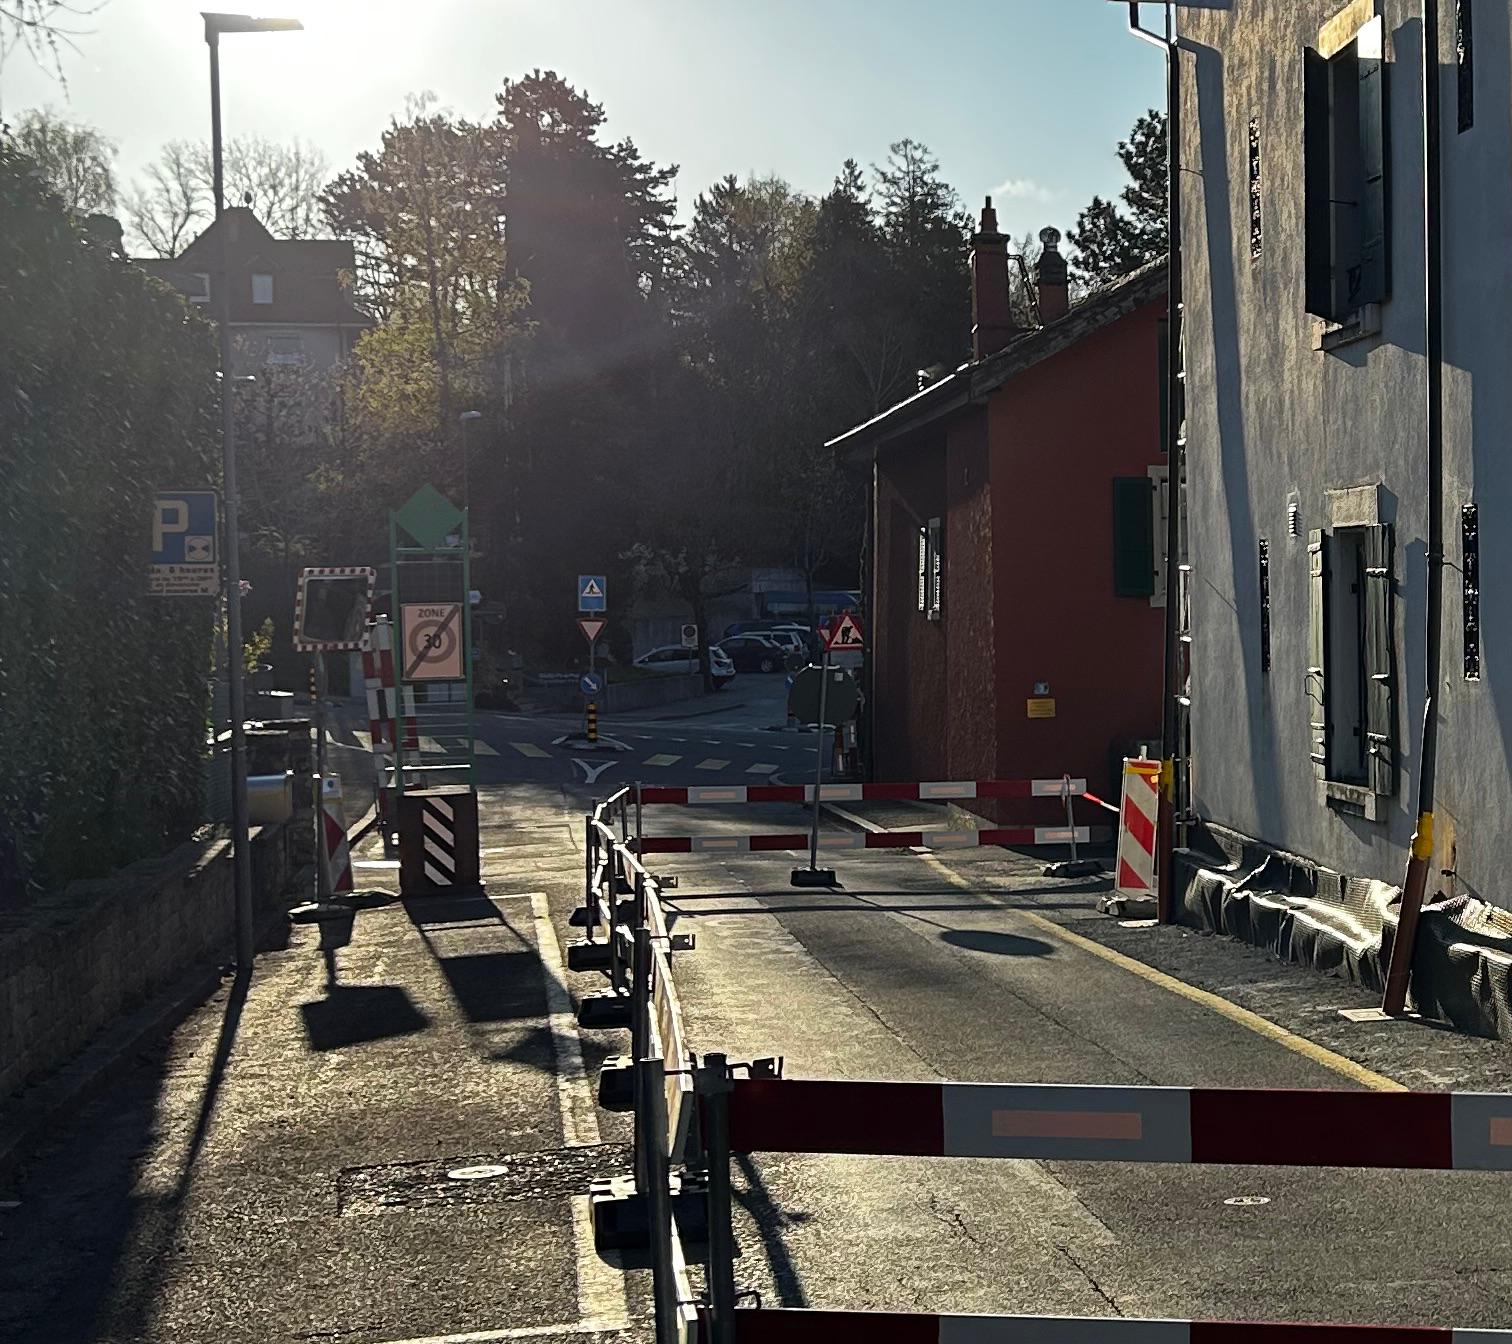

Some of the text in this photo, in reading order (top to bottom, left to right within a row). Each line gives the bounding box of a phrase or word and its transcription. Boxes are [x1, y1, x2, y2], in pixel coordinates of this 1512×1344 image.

[152, 499, 189, 552] P
[417, 608, 446, 618] ZONE
[424, 633, 442, 649] 30
